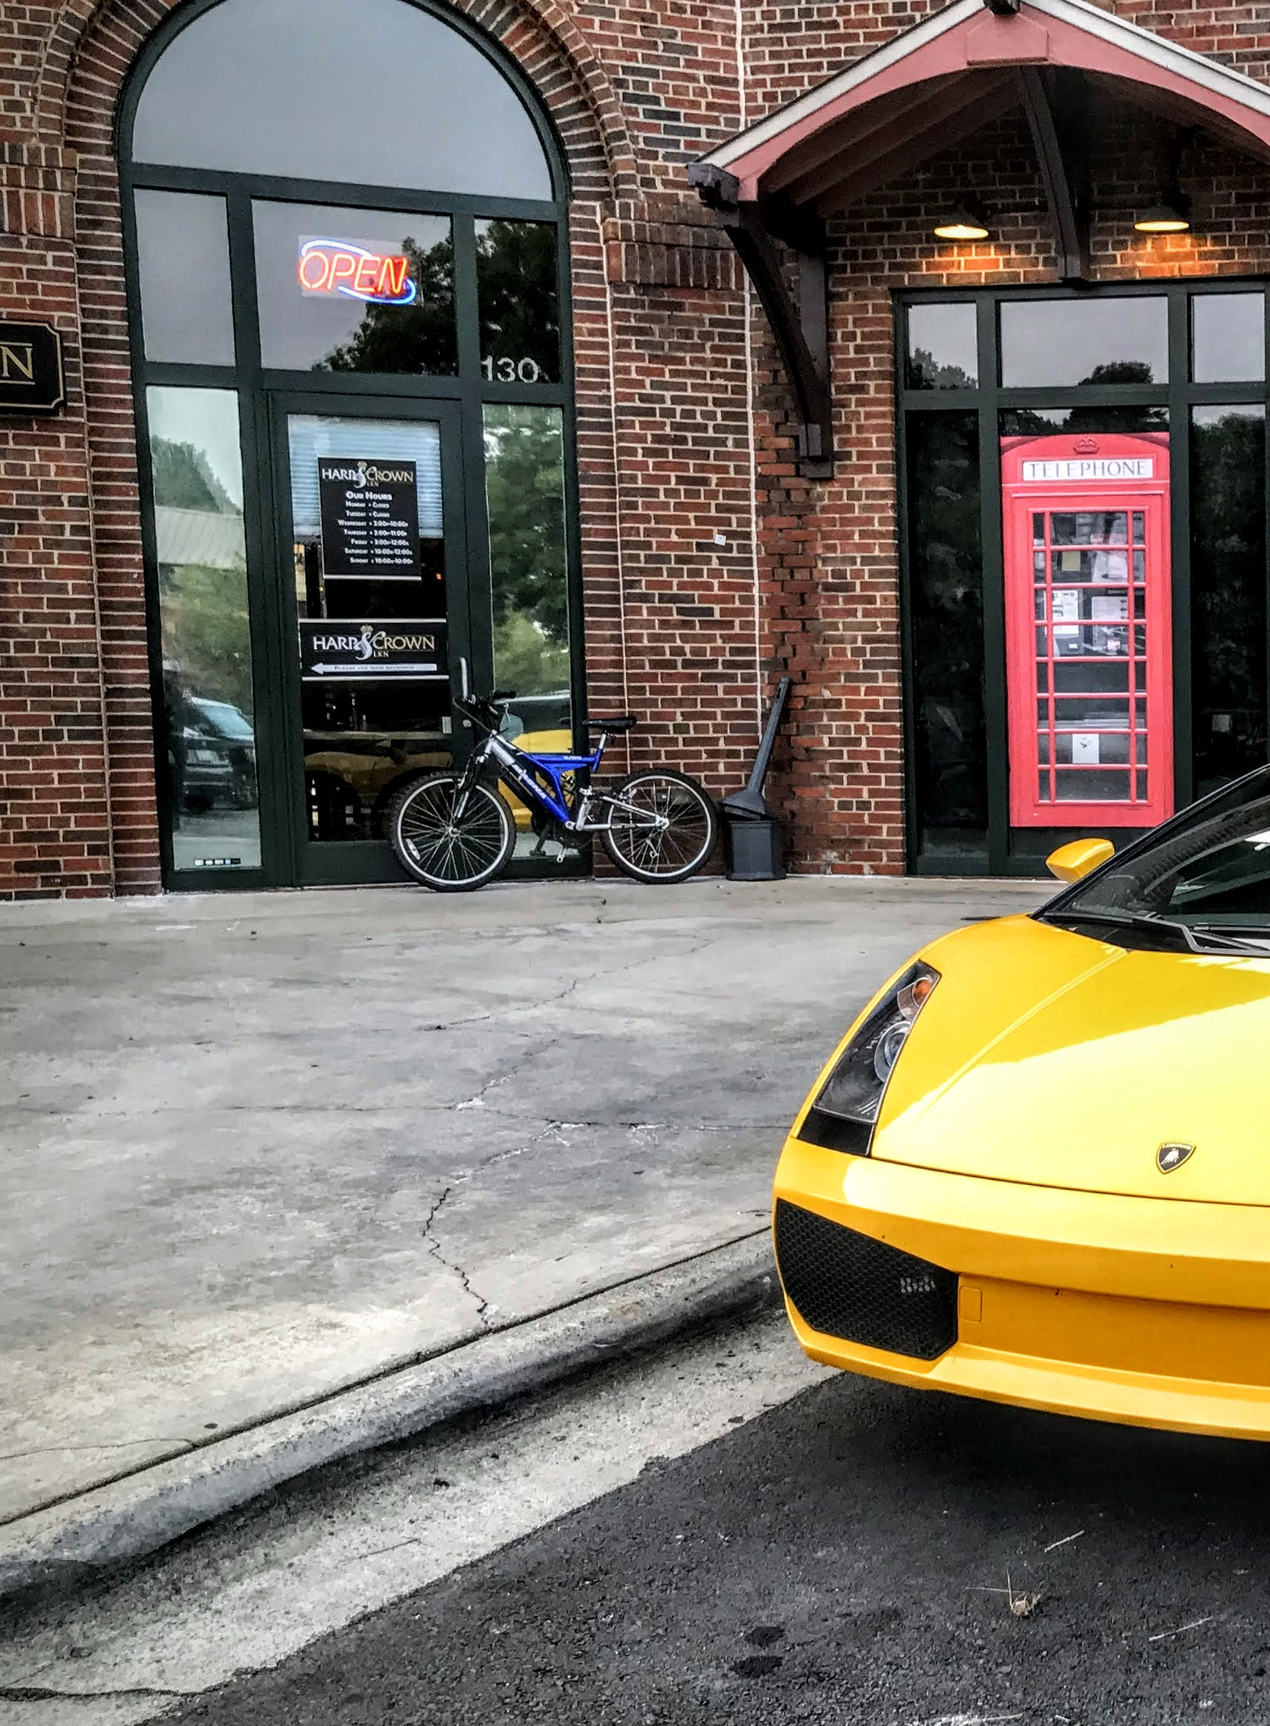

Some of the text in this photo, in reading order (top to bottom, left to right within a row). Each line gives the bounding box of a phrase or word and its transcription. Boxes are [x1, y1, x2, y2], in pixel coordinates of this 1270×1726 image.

[298, 250, 407, 294] OPEN
[0, 346, 34, 380] N
[481, 355, 539, 383] 130
[322, 468, 356, 480] HARP
[366, 470, 414, 482] CROWN
[1030, 460, 1147, 478] TELEPHONE
[345, 490, 393, 500] OUR HOURS
[313, 636, 357, 650] HARP
[372, 636, 435, 650] CROWN
[373, 650, 389, 658] LKN
